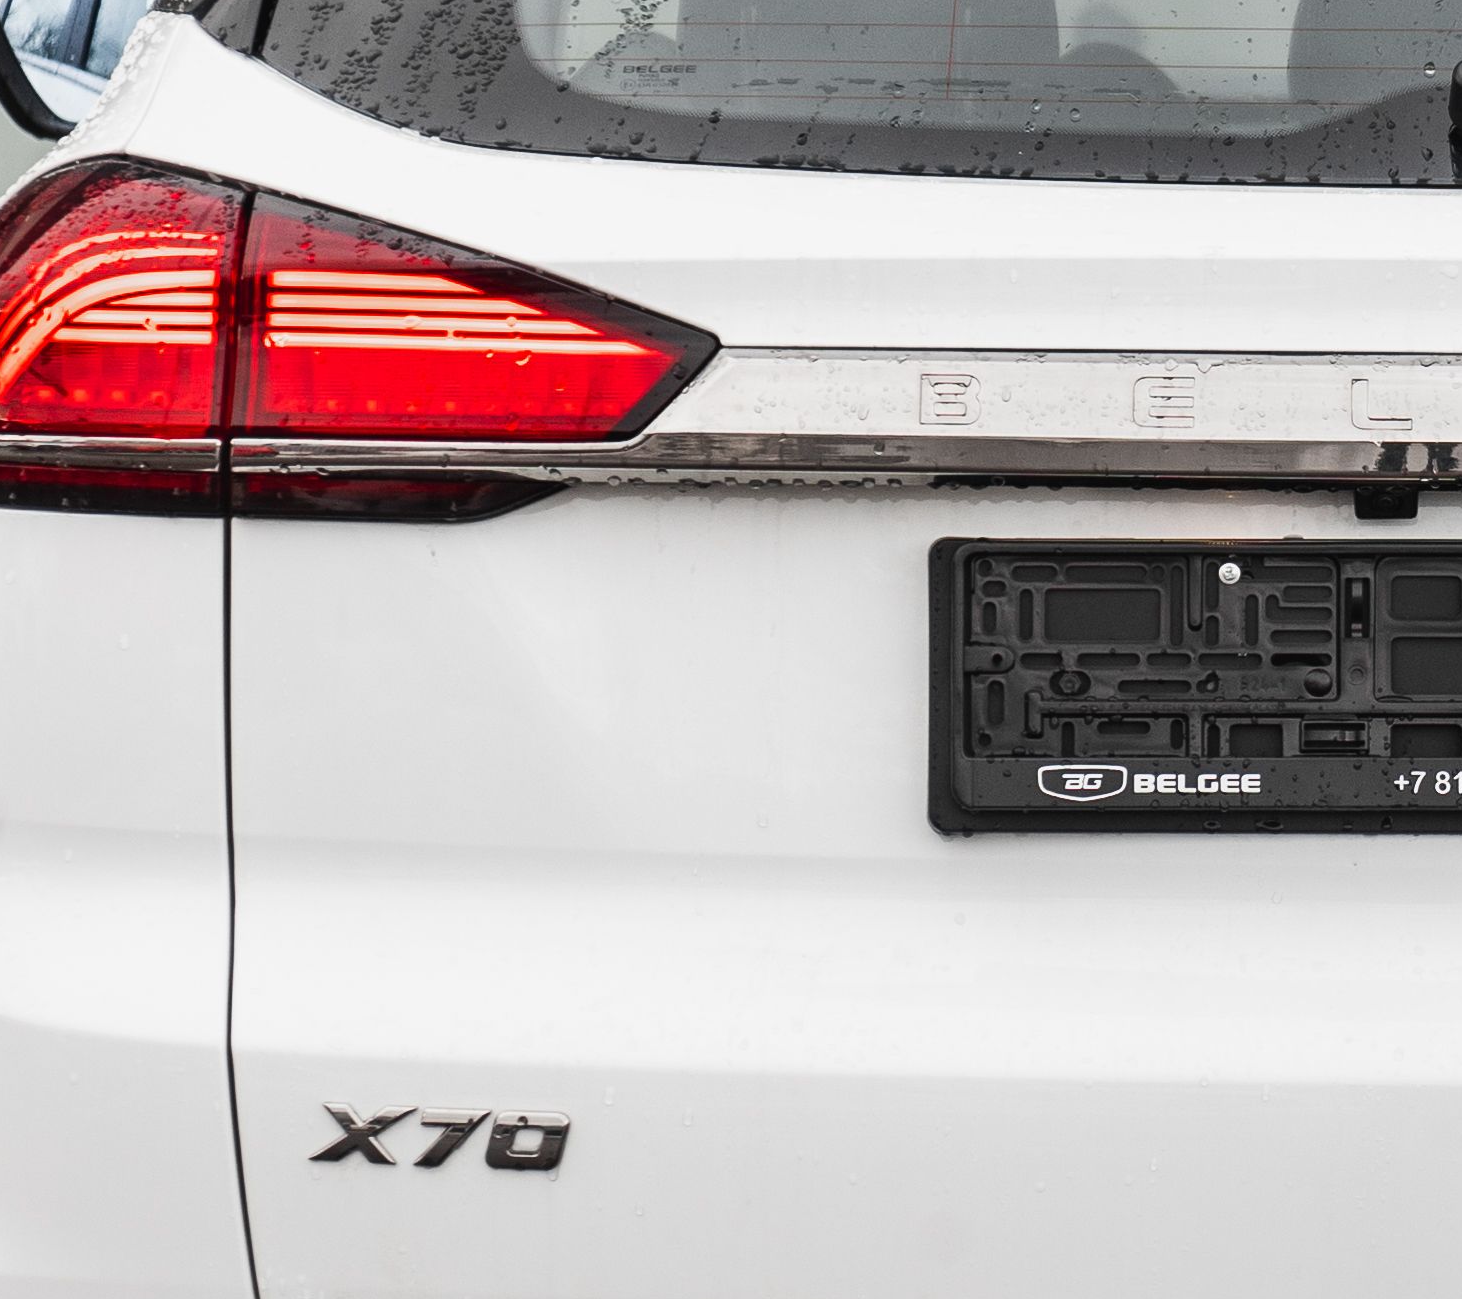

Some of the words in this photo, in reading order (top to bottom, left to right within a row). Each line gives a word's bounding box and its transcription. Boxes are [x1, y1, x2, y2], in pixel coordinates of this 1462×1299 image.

[1133, 773, 1261, 793] BELGEE
[1393, 771, 1426, 794] +7
[307, 1101, 572, 1171] X70
